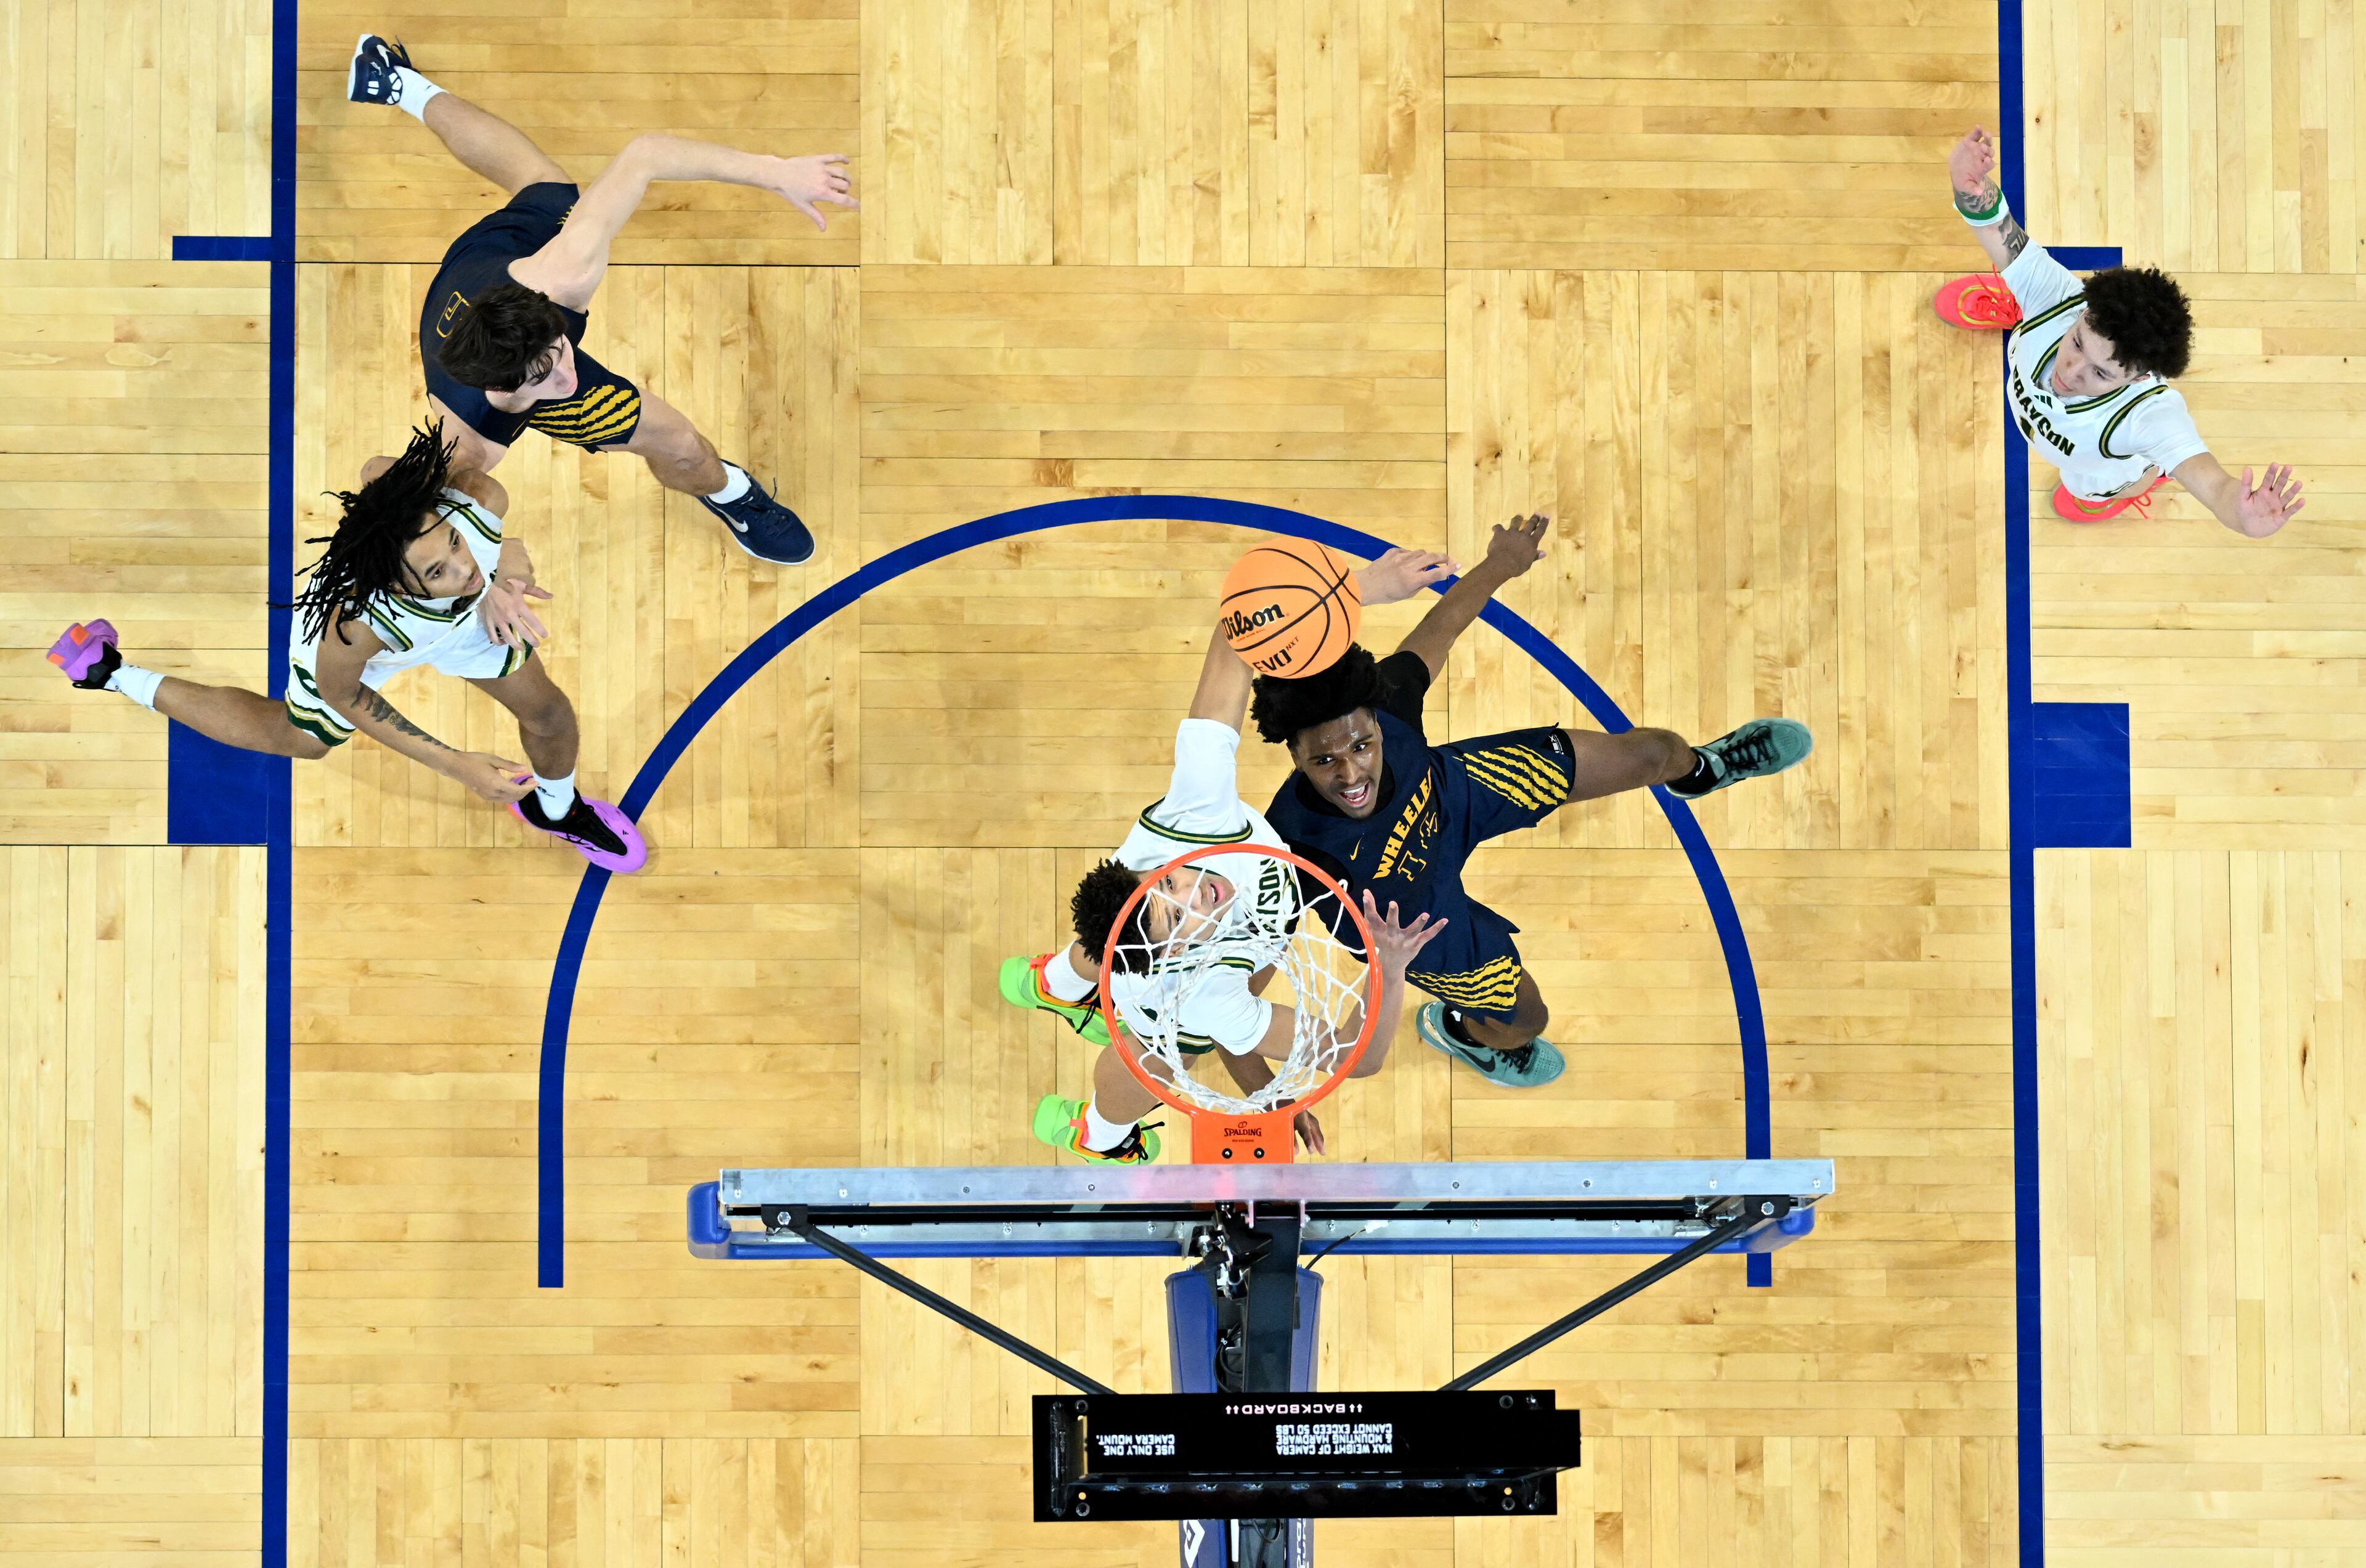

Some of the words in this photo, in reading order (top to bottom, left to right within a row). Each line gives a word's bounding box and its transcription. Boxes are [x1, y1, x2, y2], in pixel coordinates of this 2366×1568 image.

[1285, 636, 1299, 651] NXT
[1372, 766, 1431, 879] WHEELE
[1224, 1127, 1262, 1137] SPALDING
[1242, 1403, 1346, 1415] BACKBOARD
[1275, 1424, 1295, 1435] LBS
[1297, 1424, 1310, 1434] 50
[1313, 1424, 1351, 1434] EXCEED
[1353, 1423, 1392, 1434] CANNOT
[1096, 1434, 1132, 1445] MOUNT.
[1135, 1434, 1175, 1445] CAMERA
[1276, 1434, 1329, 1445] HARDWARE
[1332, 1434, 1383, 1444] MOUNTING
[1385, 1434, 1392, 1444] &
[1104, 1445, 1124, 1456] ONE
[1126, 1445, 1152, 1455] ONLY
[1155, 1445, 1175, 1455] USE
[1276, 1444, 1315, 1455] CAMERA
[1318, 1444, 1331, 1455] OF
[1333, 1444, 1370, 1454] WEIGHT
[1372, 1444, 1392, 1453] MAX
